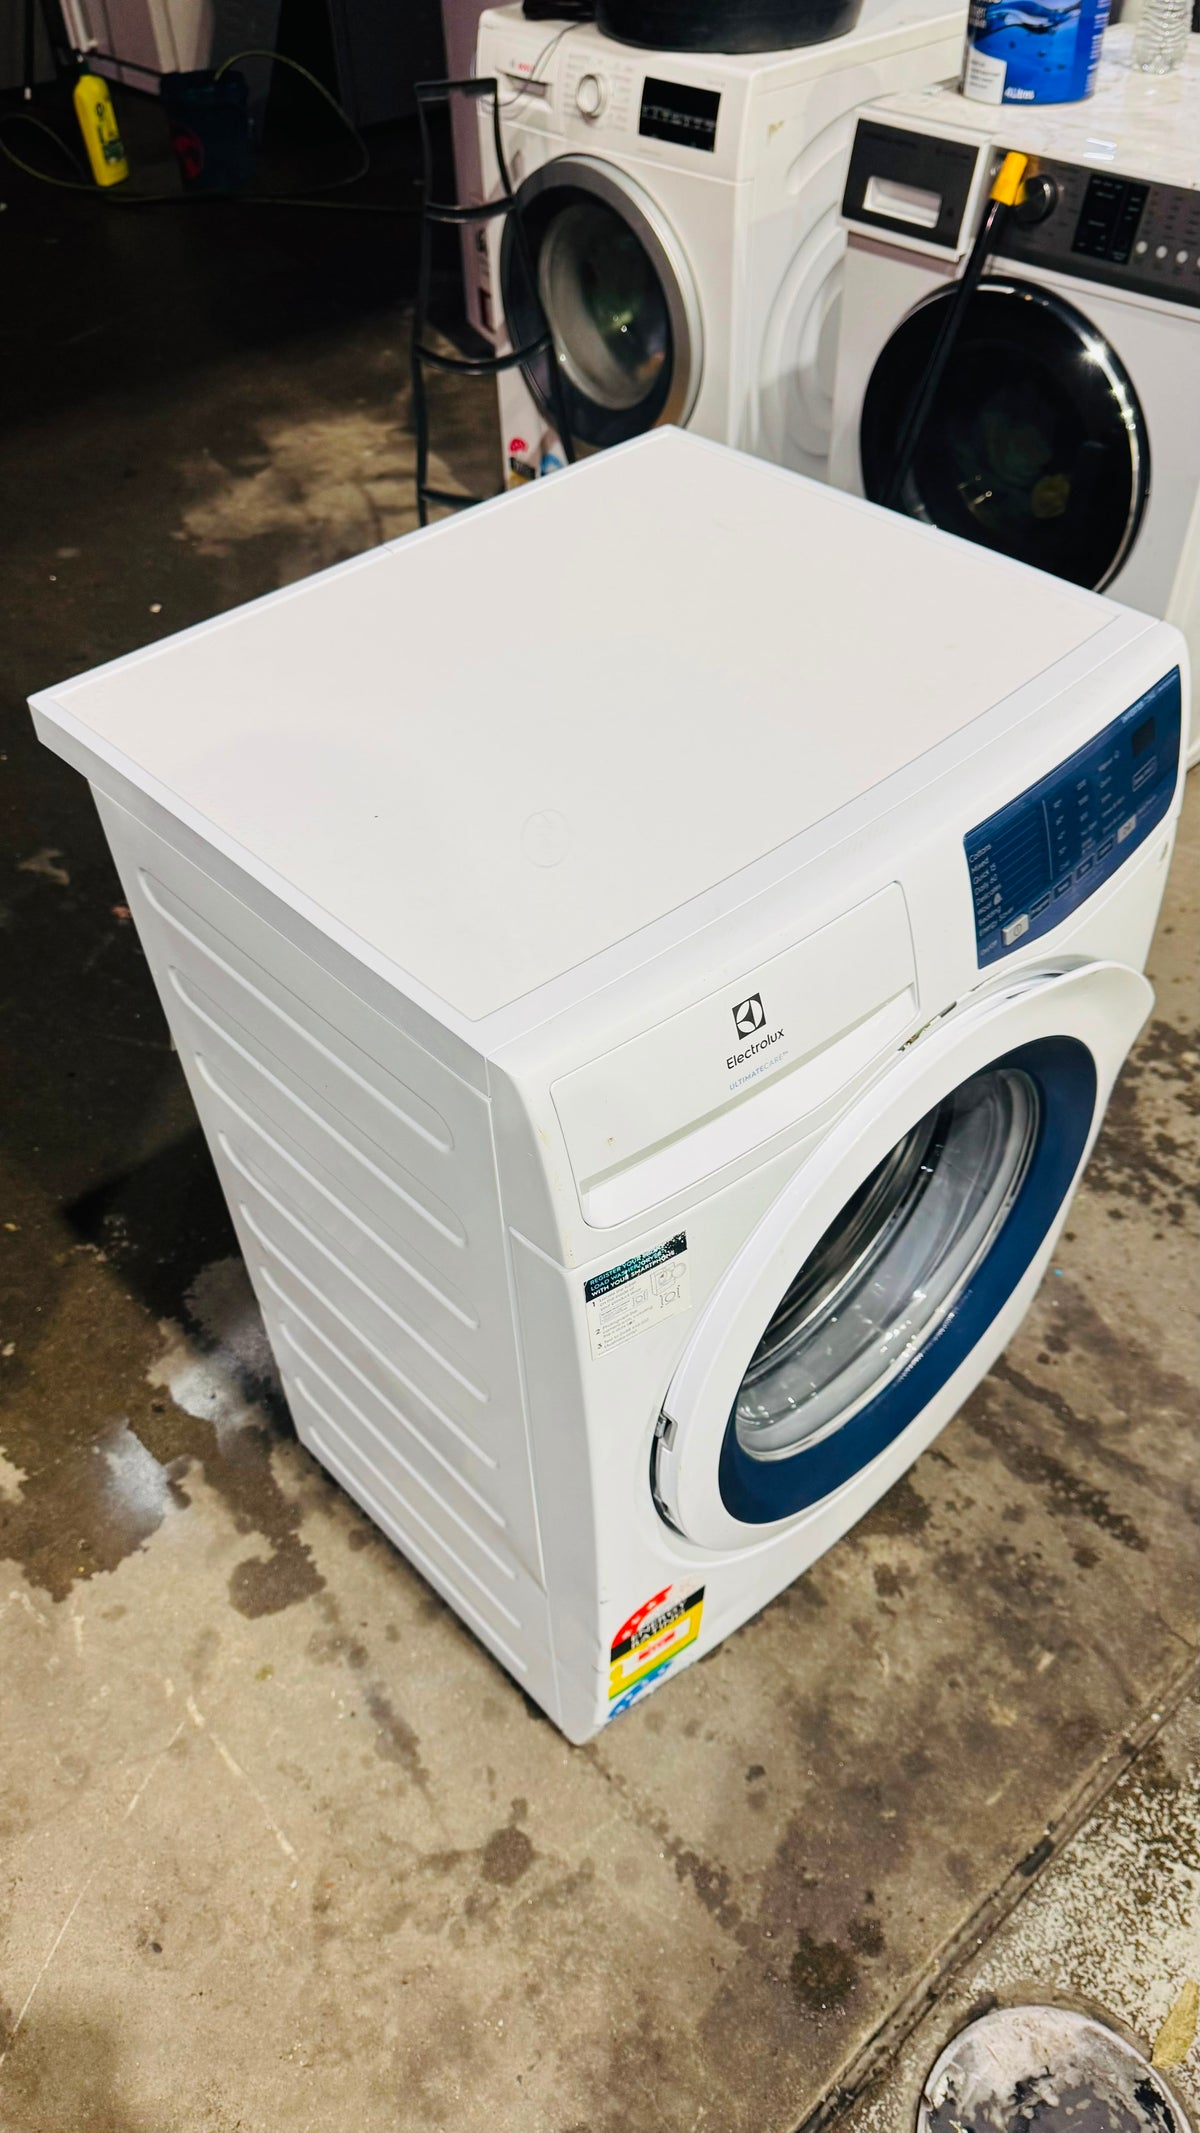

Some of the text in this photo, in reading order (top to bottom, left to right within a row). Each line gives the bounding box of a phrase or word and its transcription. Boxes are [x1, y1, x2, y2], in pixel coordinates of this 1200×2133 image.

[726, 1028, 785, 1070] Electrolux
[590, 1264, 621, 1286] REGISTER
[591, 1279, 610, 1292] LOAD
[591, 1285, 610, 1297] WITH
